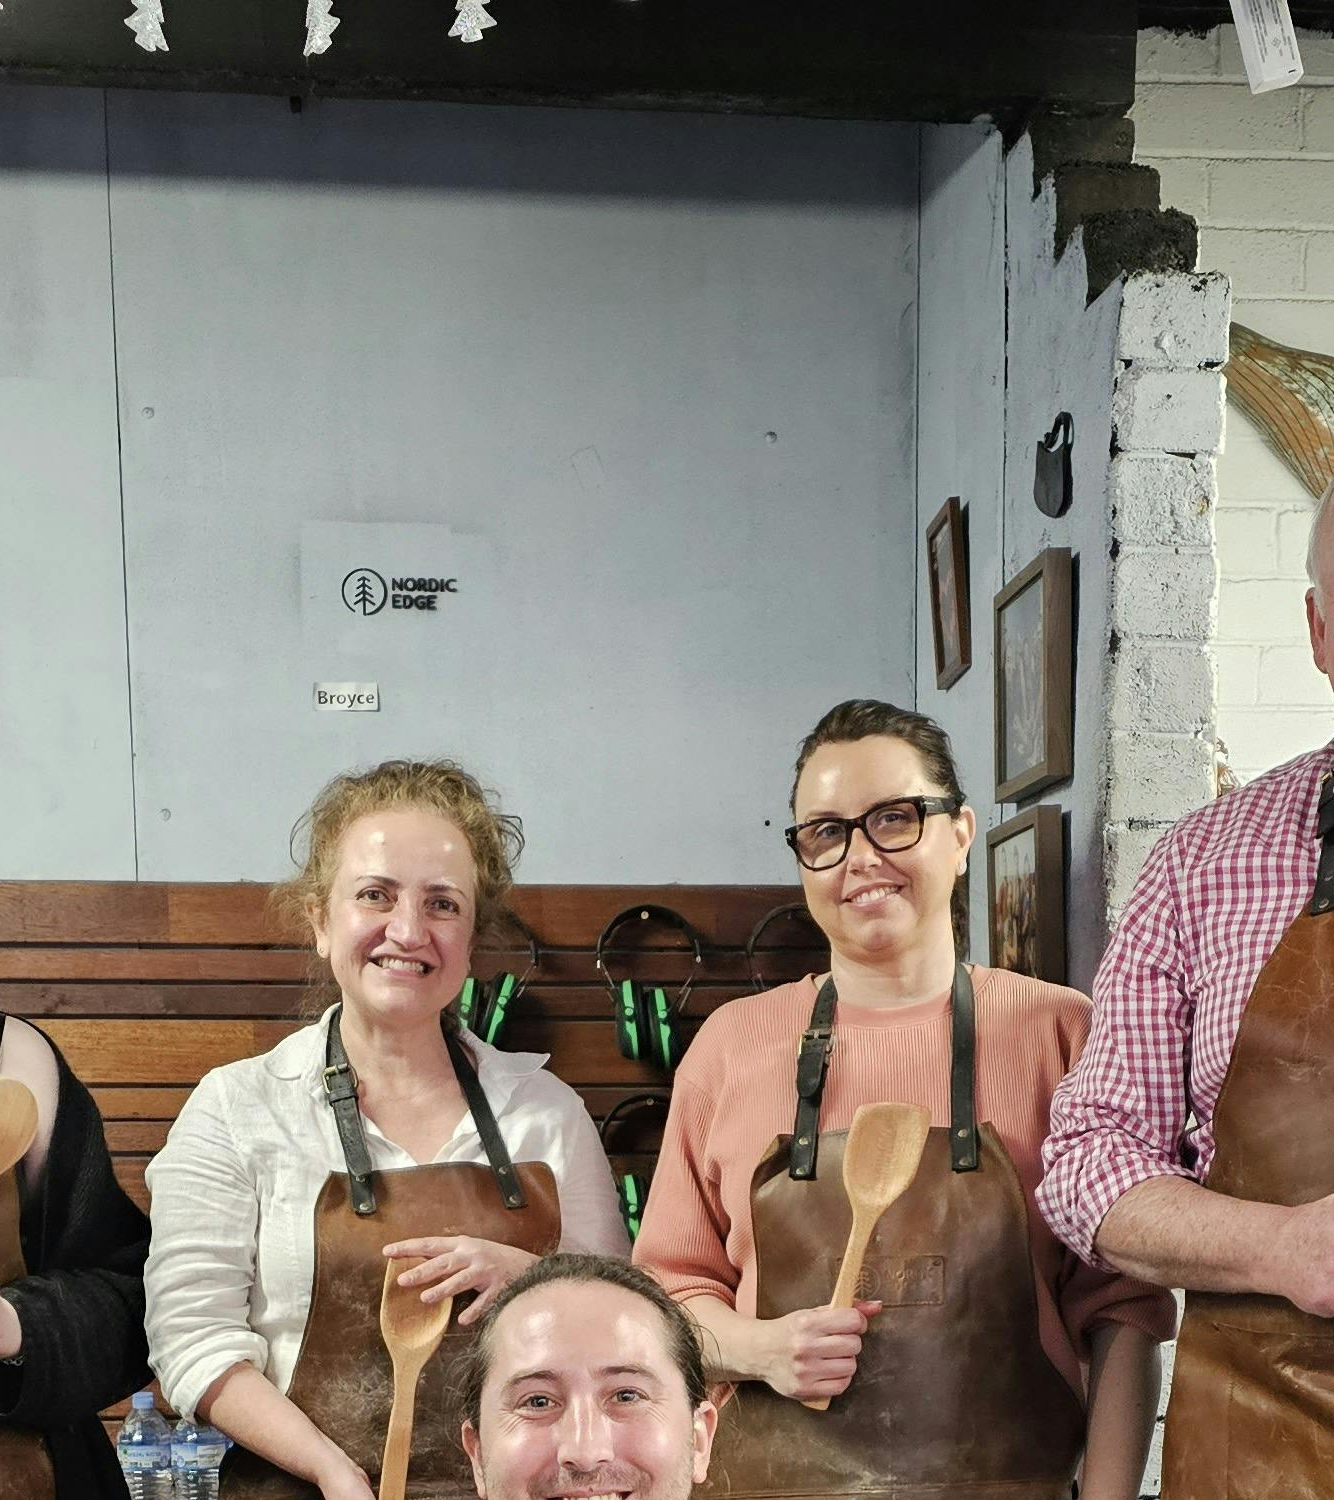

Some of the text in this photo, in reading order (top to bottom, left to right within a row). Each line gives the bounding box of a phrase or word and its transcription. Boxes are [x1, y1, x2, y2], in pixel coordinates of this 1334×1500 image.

[391, 577, 458, 593] NORDIC
[391, 594, 438, 611] EDGE
[317, 690, 375, 708] Broyce
